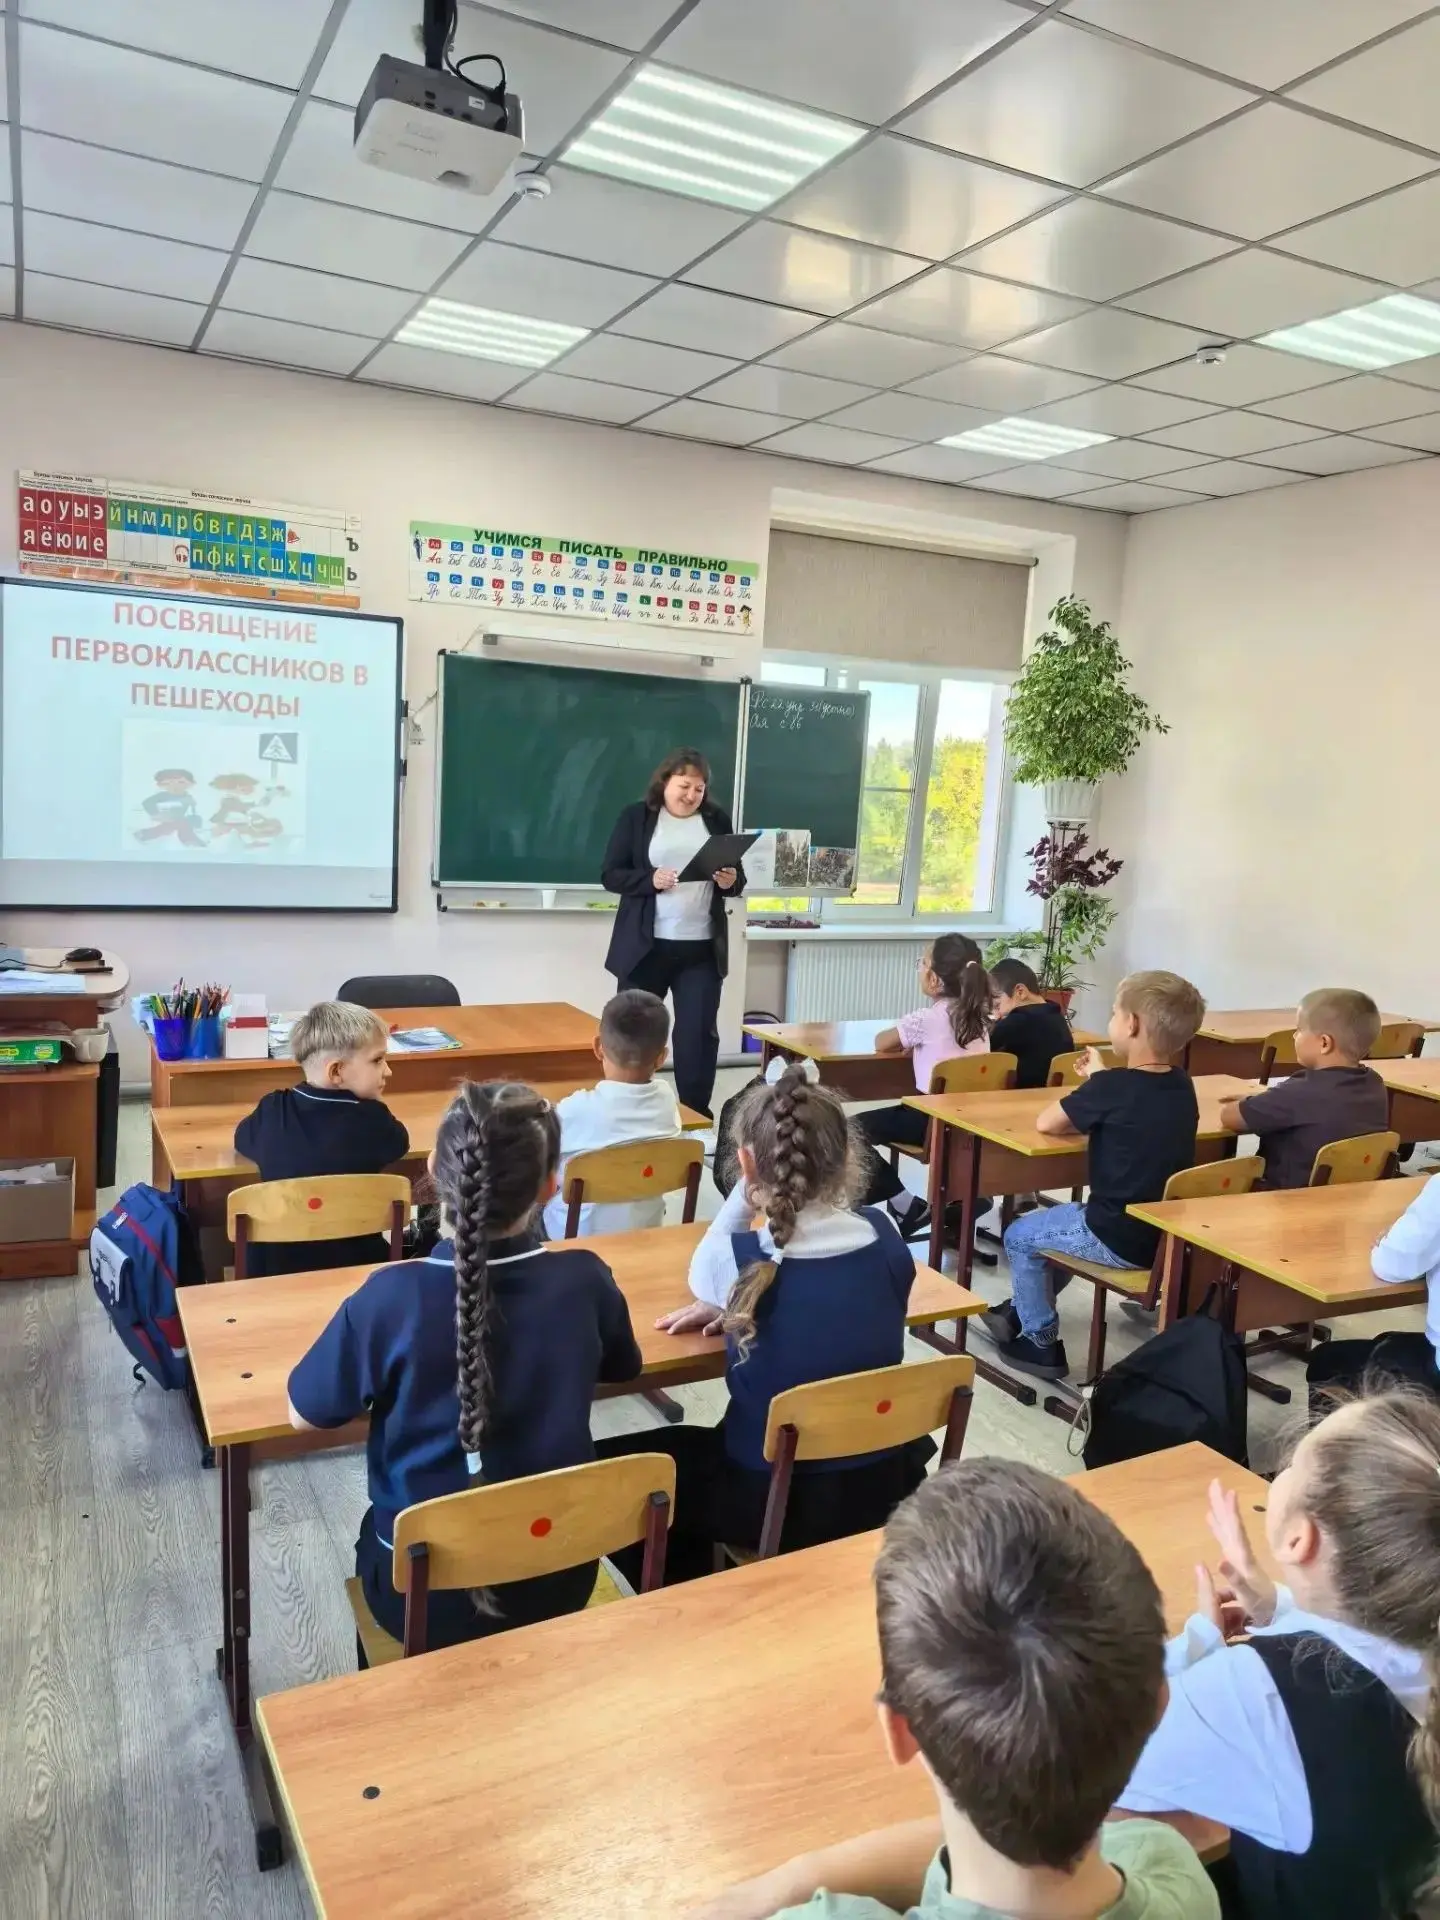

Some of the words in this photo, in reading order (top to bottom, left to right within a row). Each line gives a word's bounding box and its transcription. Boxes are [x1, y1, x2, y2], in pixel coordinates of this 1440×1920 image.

[23, 496, 34, 512] а
[41, 499, 52, 514] о
[59, 501, 70, 521] у
[74, 502, 88, 518] ы
[94, 505, 104, 520] э
[127, 509, 137, 524] н
[142, 510, 156, 526] м
[210, 519, 219, 533] в
[227, 522, 234, 535] г
[241, 525, 252, 541] д
[258, 526, 266, 539] з
[271, 527, 284, 542] ж
[24, 529, 34, 544] я
[41, 526, 52, 546] ё
[57, 533, 71, 548] ю
[76, 535, 87, 550] и
[94, 538, 104, 551] е
[193, 549, 203, 563] п
[208, 546, 220, 570] ф
[225, 553, 234, 566] к
[242, 554, 251, 568] т
[259, 557, 265, 570] с
[271, 558, 283, 572] ш
[288, 560, 296, 574] х
[302, 561, 312, 579] ц
[474, 529, 542, 549] УЧИМСЯ
[559, 540, 624, 559] ПИСАТЬ
[638, 550, 729, 572] ПРАВИЛЬНО
[113, 602, 318, 644] ПОСВЯЩЕНИЕ
[51, 636, 344, 684] ПЕРВОКЛАССНИКОВ
[354, 665, 368, 686] В
[131, 683, 300, 720] ПЕШЕХОДЫ
